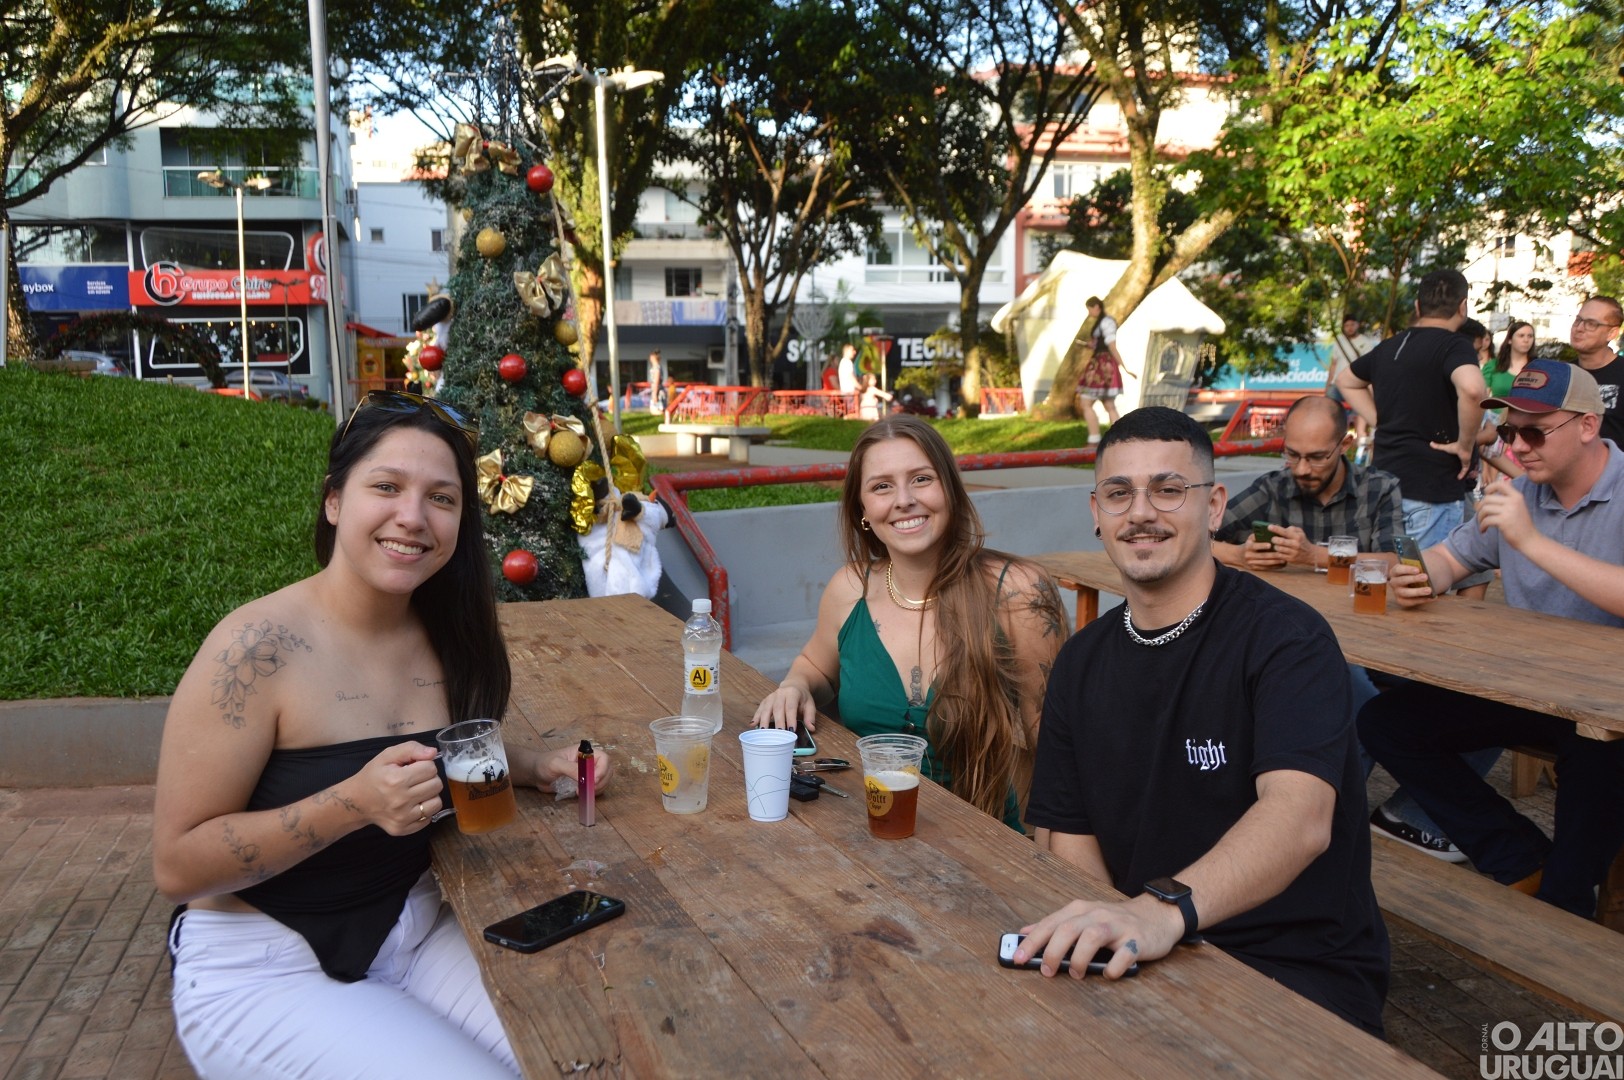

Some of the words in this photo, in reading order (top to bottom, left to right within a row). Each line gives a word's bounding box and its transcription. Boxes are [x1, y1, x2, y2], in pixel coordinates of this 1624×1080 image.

[22, 282, 54, 294] aybox
[180, 276, 228, 292] Grupo
[692, 669, 707, 686] AJ
[1185, 738, 1227, 770] fight
